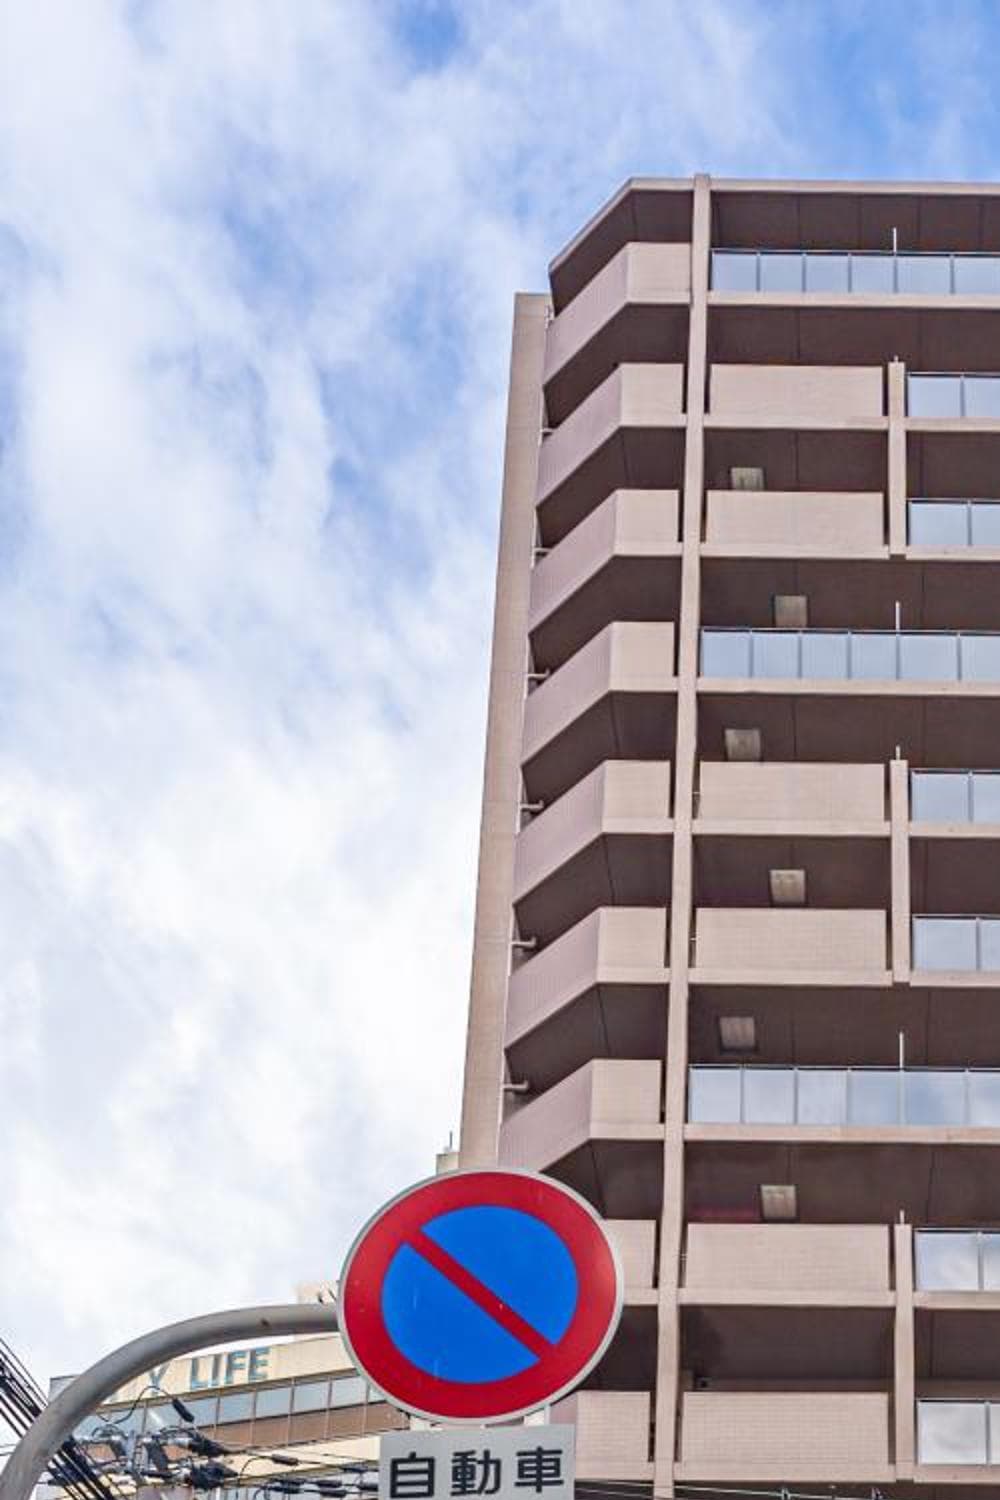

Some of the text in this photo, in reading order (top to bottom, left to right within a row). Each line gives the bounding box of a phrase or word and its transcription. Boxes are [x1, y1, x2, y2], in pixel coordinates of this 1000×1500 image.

[190, 1347, 271, 1390] LIFE
[389, 1446, 564, 1499] 自動車
